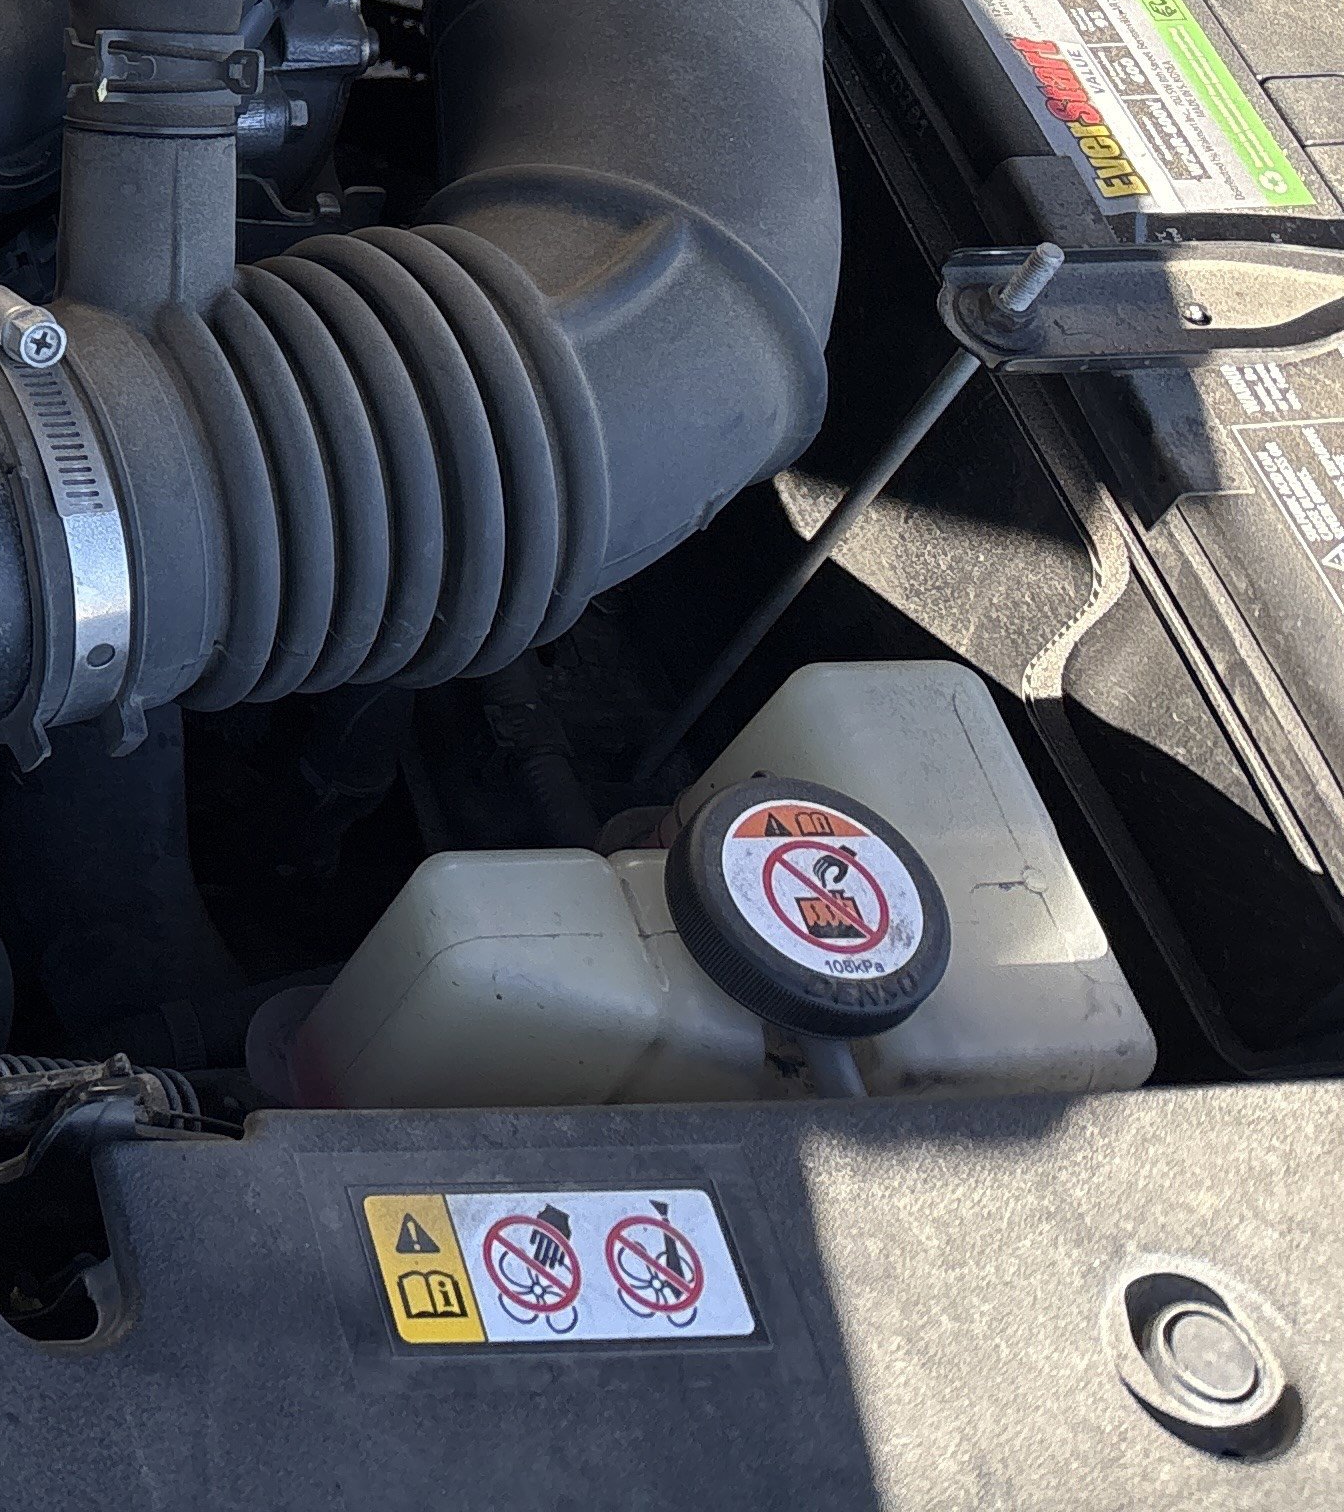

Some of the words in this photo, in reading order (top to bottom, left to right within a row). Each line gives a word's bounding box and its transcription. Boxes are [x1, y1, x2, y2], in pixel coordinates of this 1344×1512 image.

[1067, 49, 1105, 94] VALUE
[1119, 57, 1146, 84] 600
[1010, 37, 1151, 198] EverStart
[824, 958, 886, 975] 108kPa
[806, 971, 920, 1008] DENSO
